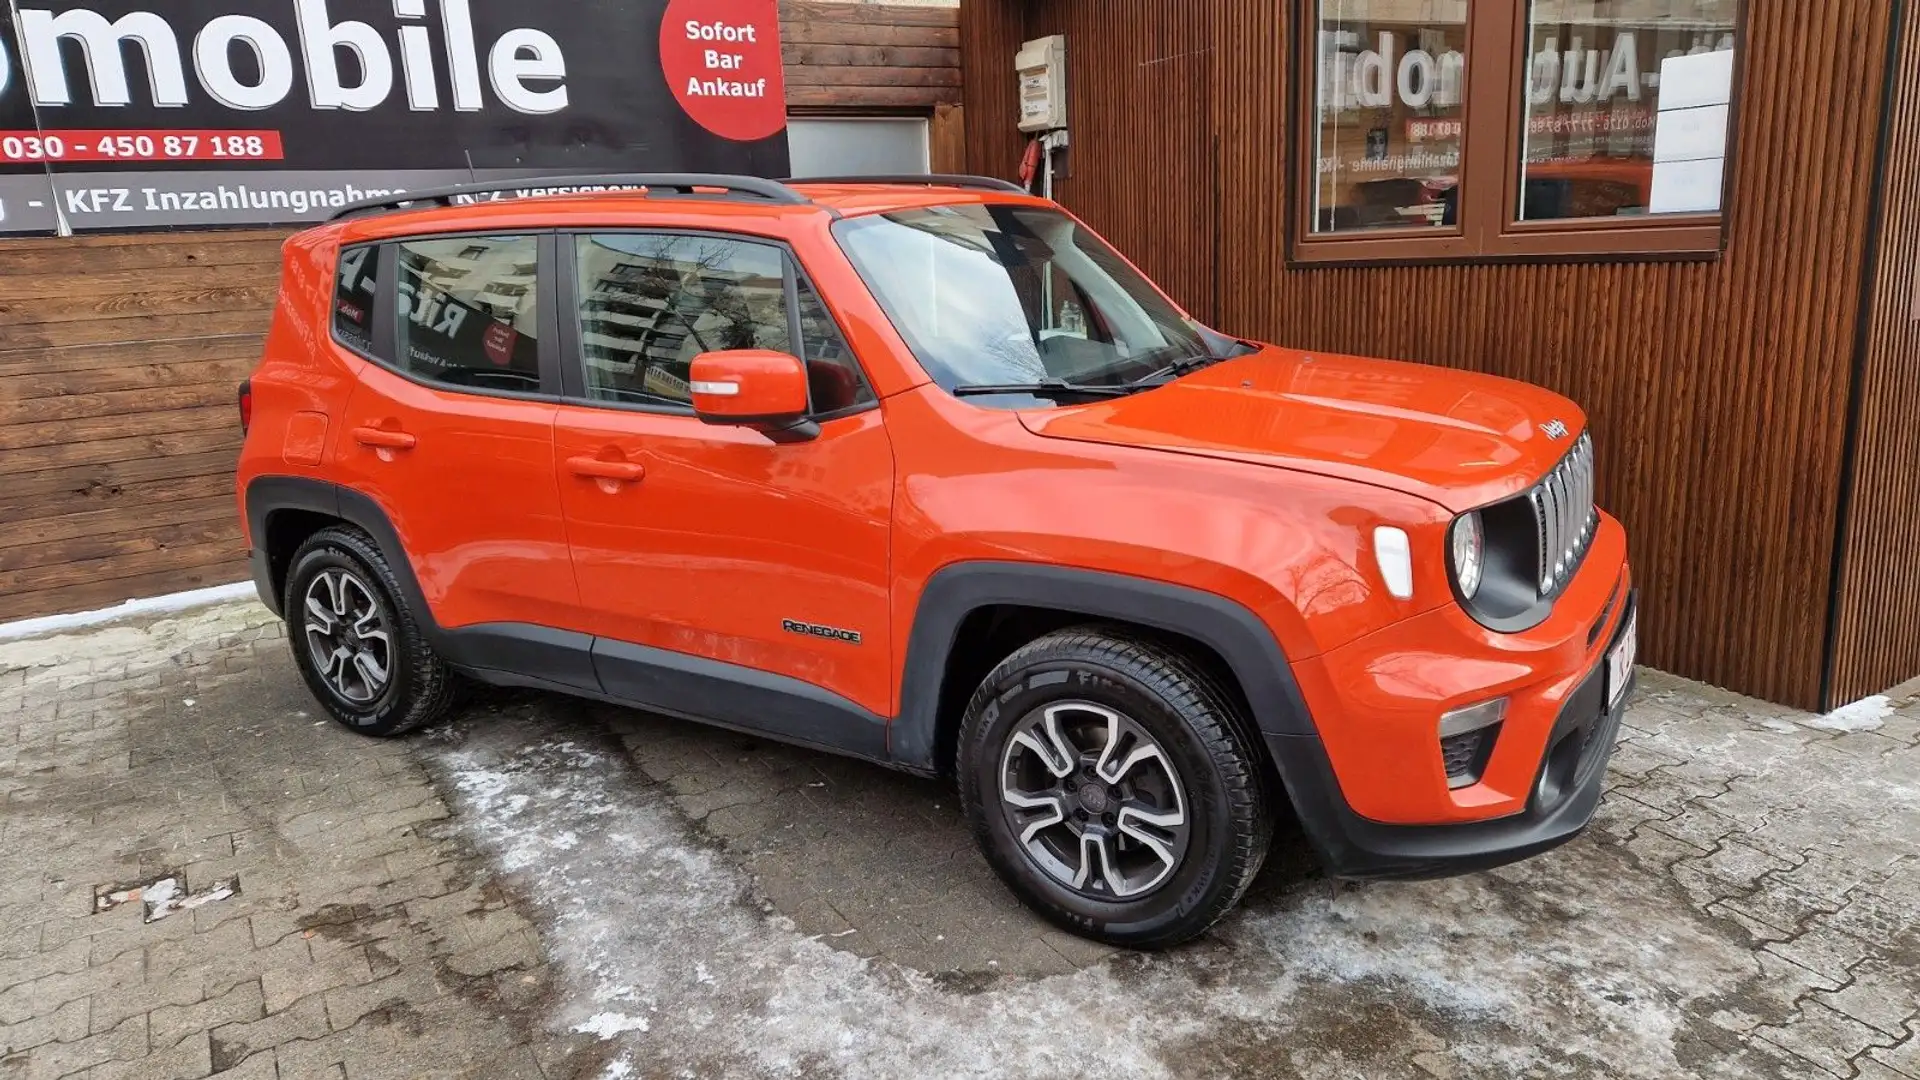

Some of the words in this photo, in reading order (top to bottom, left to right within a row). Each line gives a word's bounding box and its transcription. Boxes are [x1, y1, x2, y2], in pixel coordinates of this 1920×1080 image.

[685, 20, 756, 42] Sofort
[0, 0, 569, 114] mobile
[704, 49, 743, 69] Bar
[687, 77, 766, 97] Ankauf
[2, 136, 64, 158] 030
[97, 136, 154, 157] 450
[164, 136, 199, 157] 87
[210, 136, 263, 157] 188
[66, 188, 134, 214] KFZ
[782, 618, 862, 645] RENEGADE
